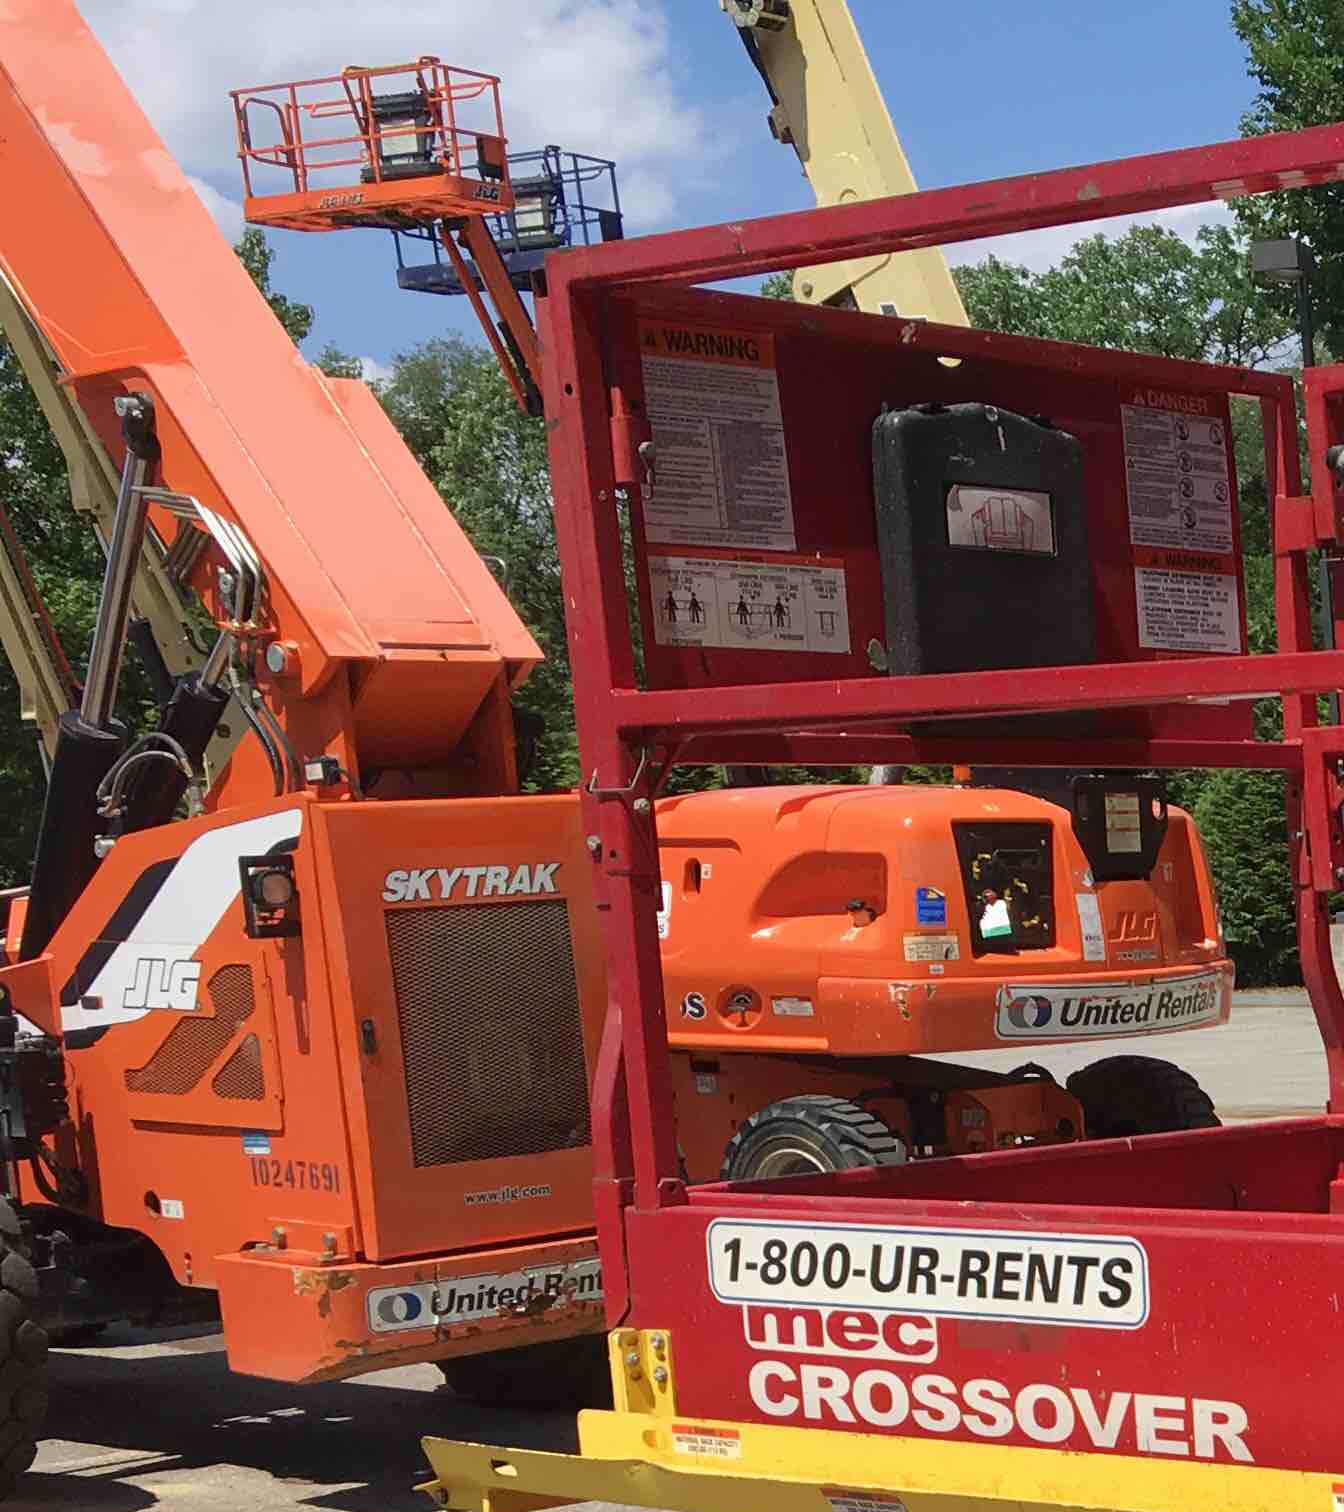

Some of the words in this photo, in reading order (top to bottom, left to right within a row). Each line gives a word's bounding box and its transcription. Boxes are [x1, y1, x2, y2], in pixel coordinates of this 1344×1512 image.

[664, 327, 760, 361] WARNING
[381, 863, 562, 902] SKYTRAK
[123, 957, 202, 1011] JLG
[1058, 994, 1152, 1028] United
[250, 1156, 341, 1194] 10247691
[464, 1184, 552, 1205] www.jlg.com
[722, 1237, 1134, 1310] 1-800-UR-RENTS
[748, 1305, 935, 1358] mec
[748, 1360, 1256, 1465] CROSSOVER
